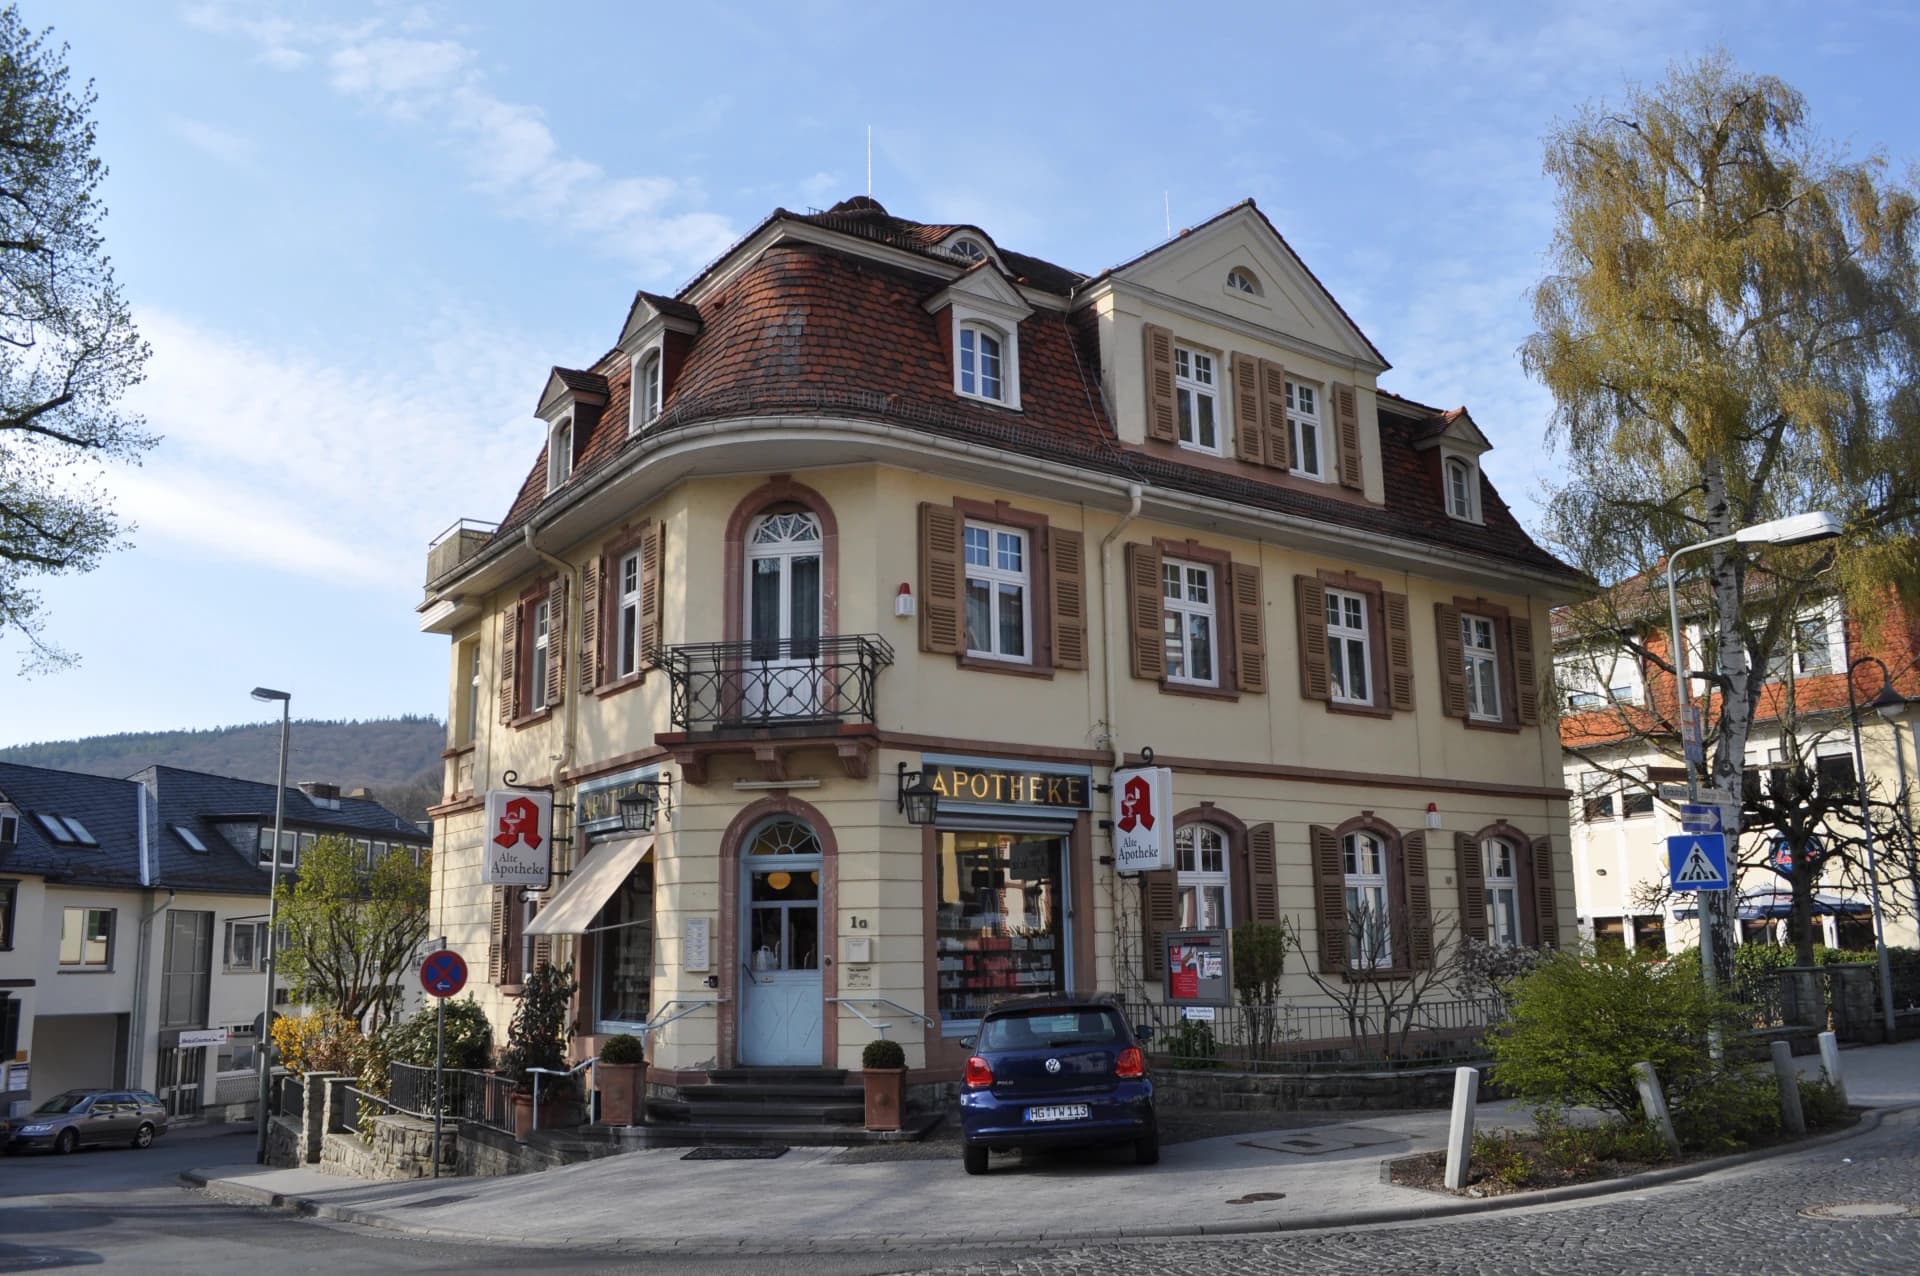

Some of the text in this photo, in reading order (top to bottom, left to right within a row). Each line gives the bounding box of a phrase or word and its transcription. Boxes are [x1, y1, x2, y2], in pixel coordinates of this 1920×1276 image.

[932, 770, 1081, 804] APOTHEKE
[1123, 837, 1137, 848] Alte
[498, 852, 518, 863] Alte
[1118, 845, 1158, 864] Apotheke
[491, 861, 545, 878] Apotheke
[850, 916, 867, 928] 1a
[1031, 1107, 1044, 1118] HG
[1067, 1105, 1086, 1116] 113
